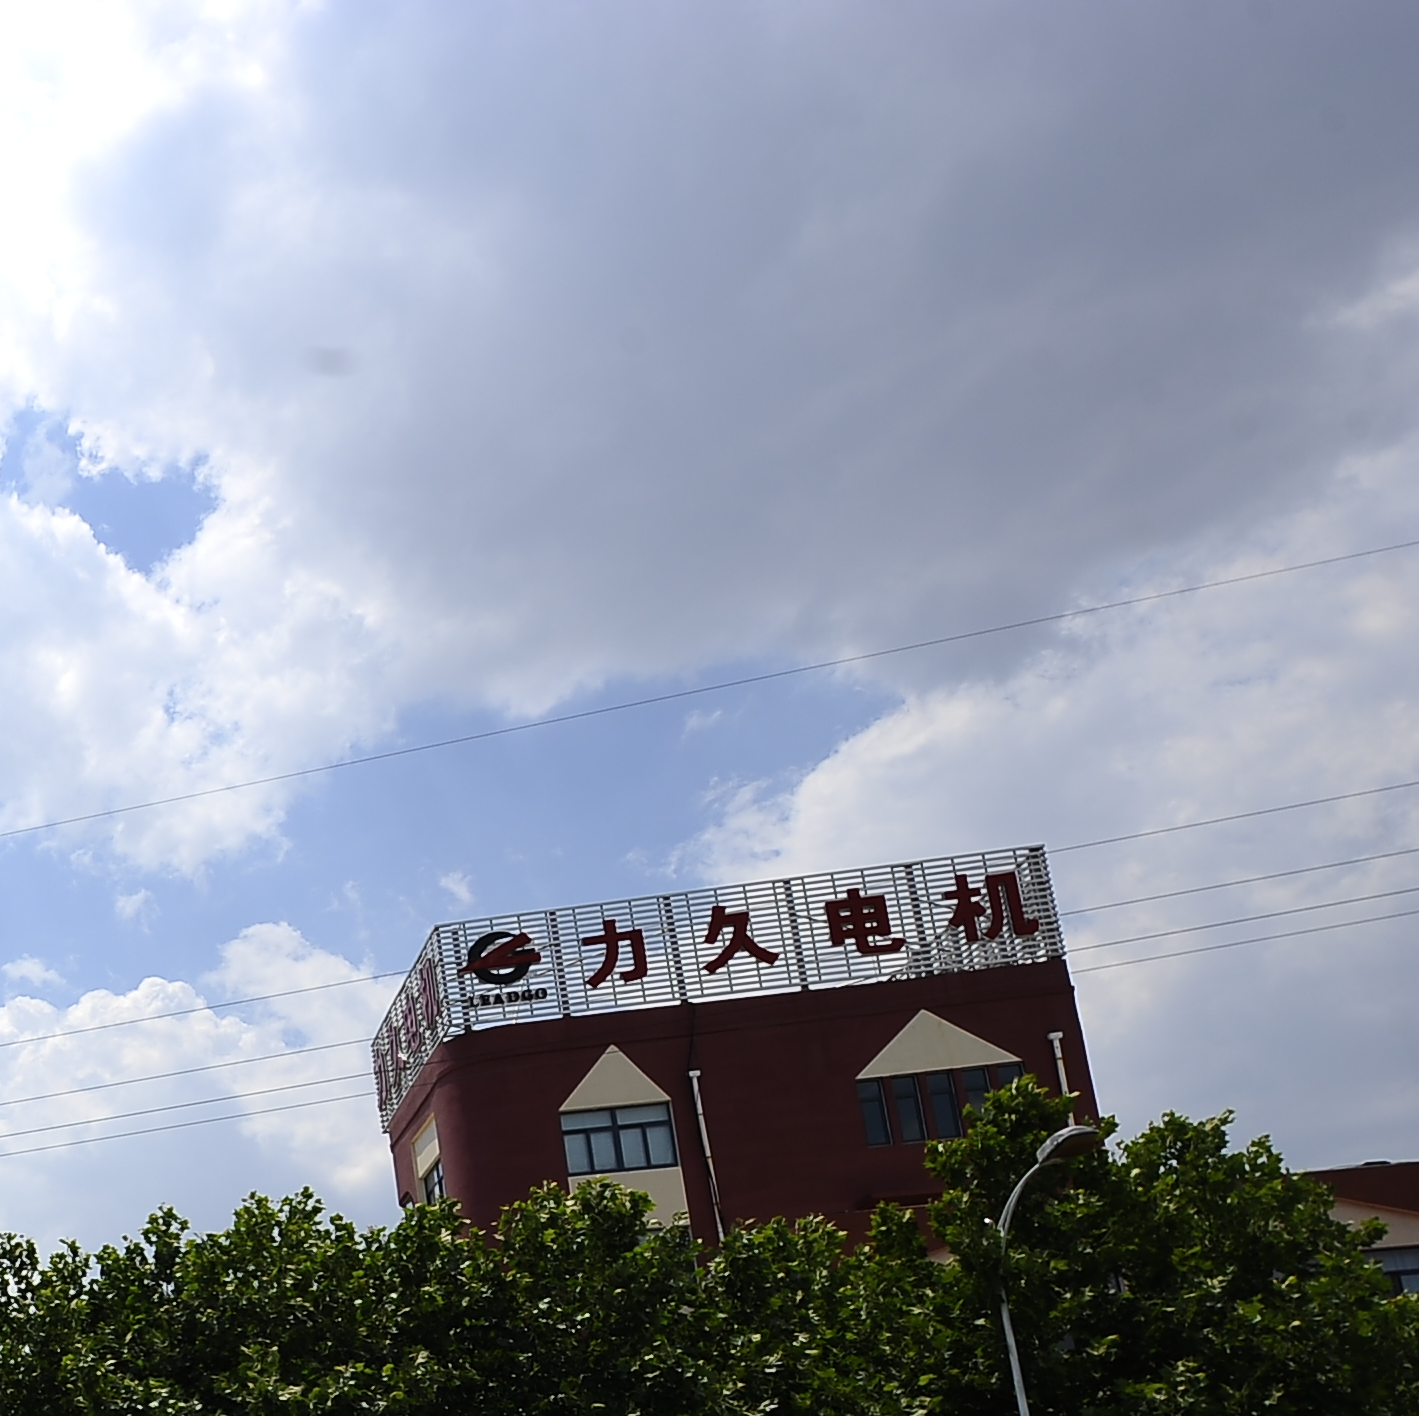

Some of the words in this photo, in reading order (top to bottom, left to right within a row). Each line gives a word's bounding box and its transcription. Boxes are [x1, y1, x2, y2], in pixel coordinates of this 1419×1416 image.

[581, 872, 1039, 988] 力久电机
[468, 987, 548, 1008] LEADGO
